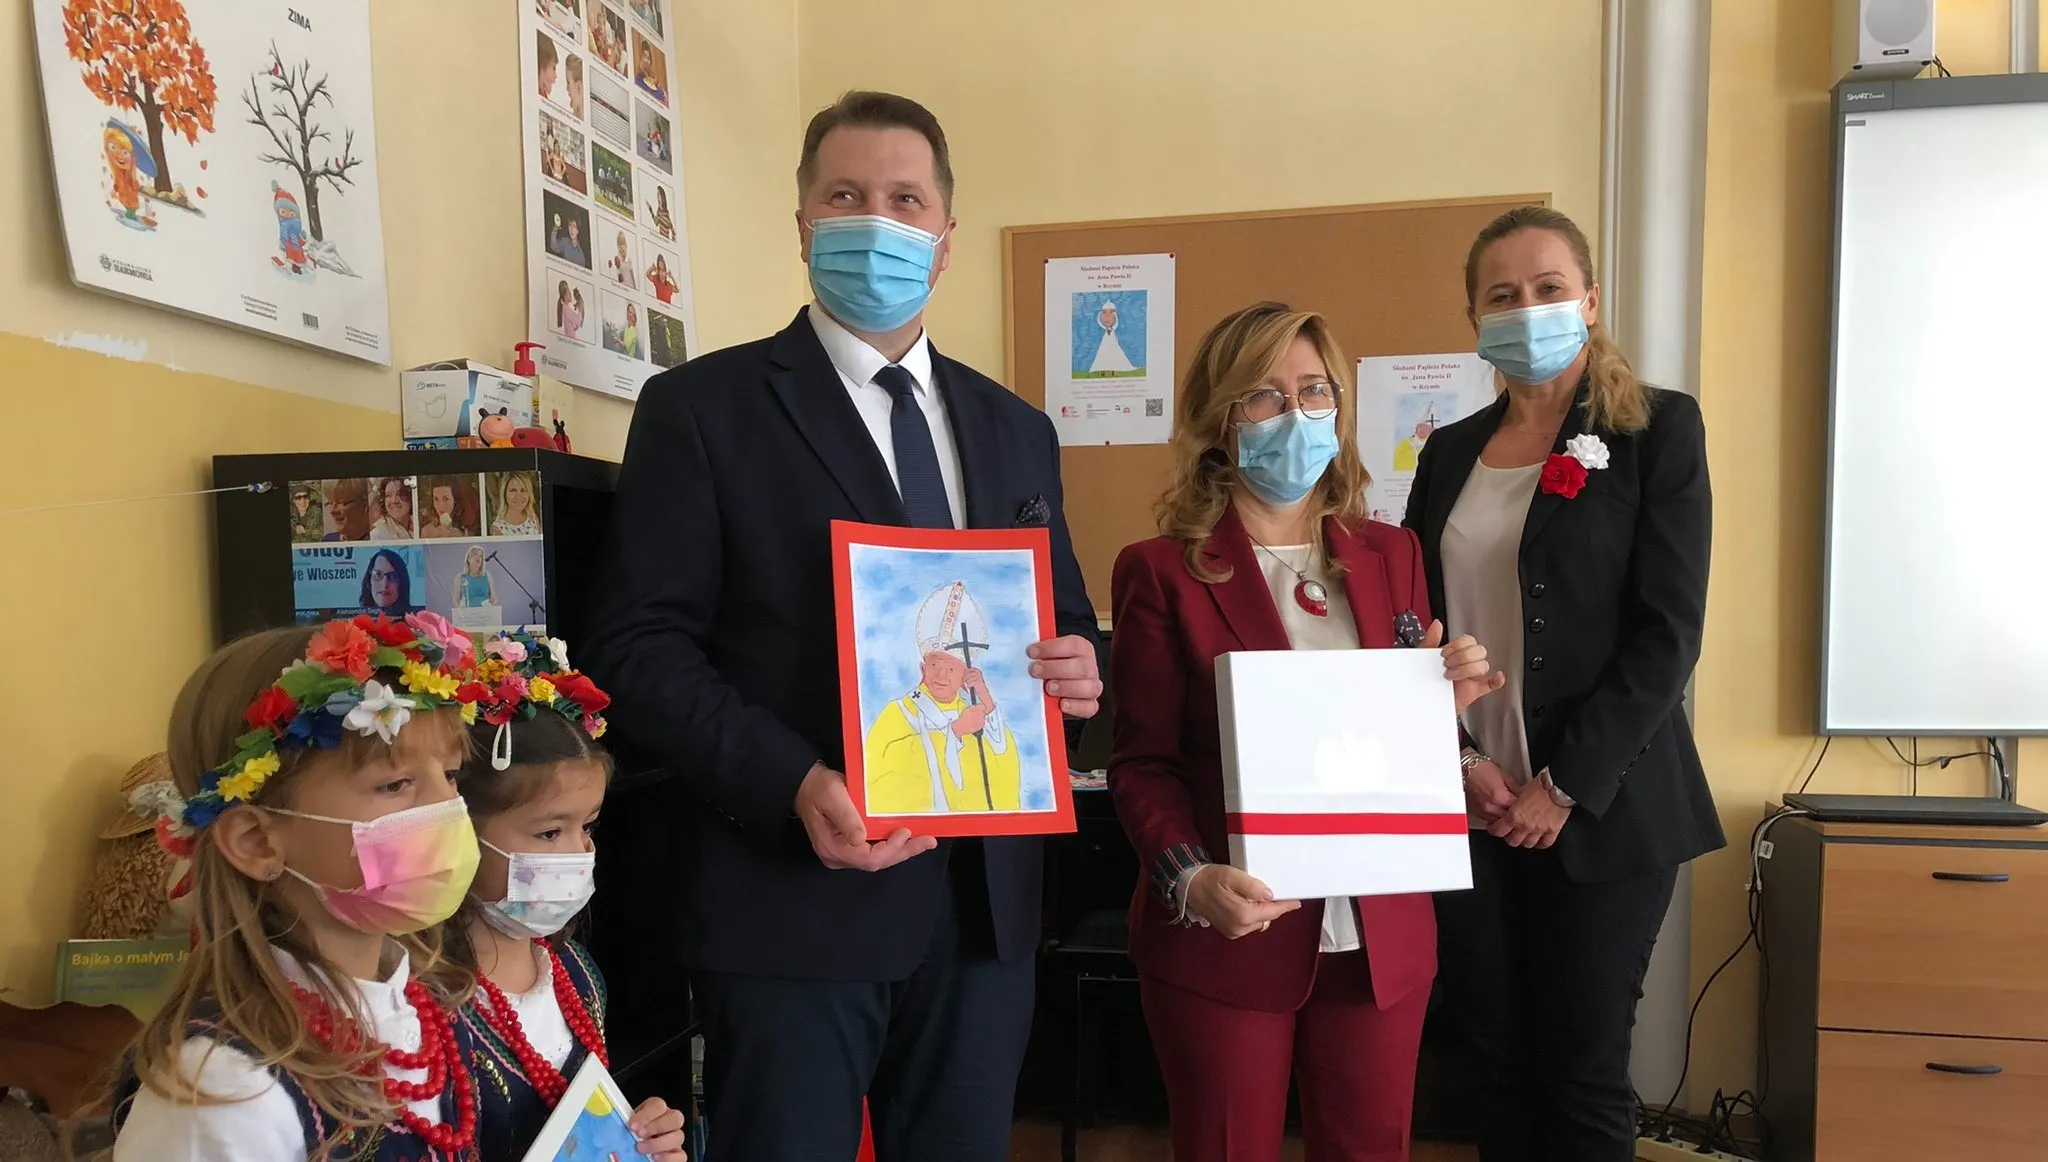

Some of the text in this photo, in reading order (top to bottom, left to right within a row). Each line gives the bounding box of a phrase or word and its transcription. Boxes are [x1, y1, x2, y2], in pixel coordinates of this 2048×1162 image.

[287, 7, 312, 32] ZIMA
[1846, 92, 1870, 101] SMART
[1440, 362, 1461, 370] Polaka
[71, 952, 110, 968] Bajka
[114, 954, 123, 964] o
